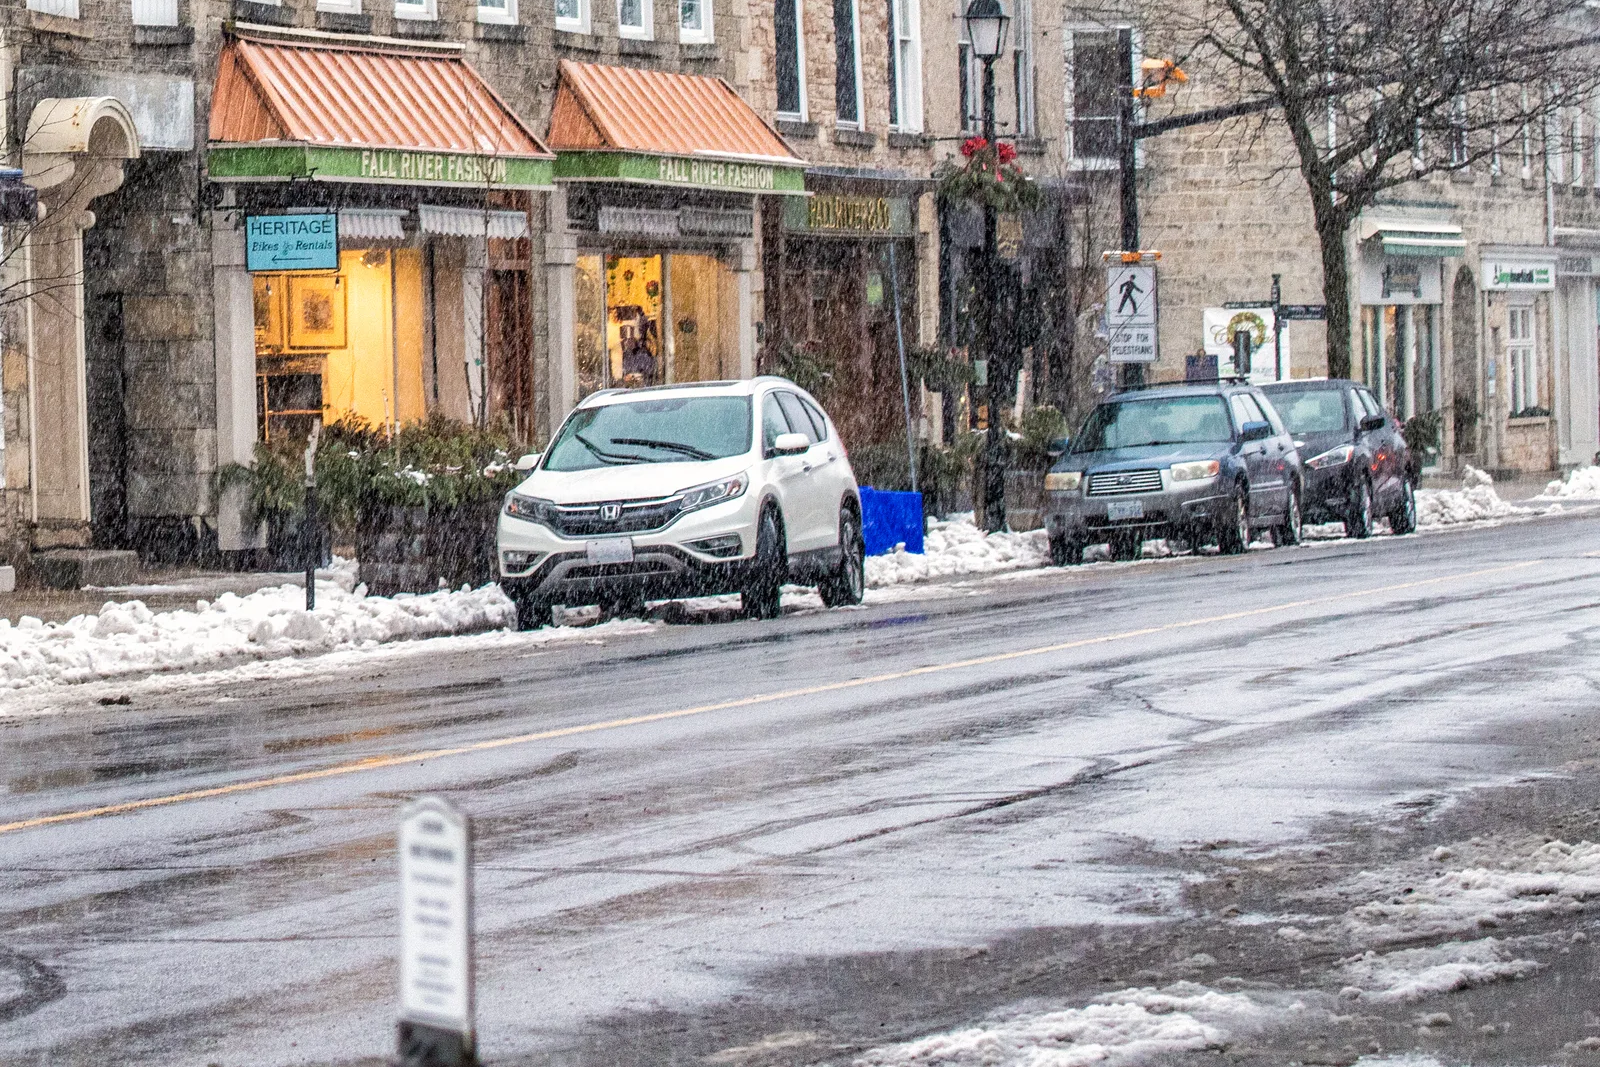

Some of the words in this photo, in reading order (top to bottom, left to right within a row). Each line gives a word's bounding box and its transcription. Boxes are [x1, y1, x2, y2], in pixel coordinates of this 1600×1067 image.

[361, 150, 397, 177] FALL
[401, 152, 444, 180] RIVER
[448, 155, 507, 183] FASHION
[659, 157, 689, 182] FALL
[691, 160, 726, 186] RIVER
[727, 164, 775, 190] FASHION
[251, 219, 332, 236] HERITAGE
[251, 240, 279, 253] Bikes
[295, 239, 333, 252] Rentals
[1136, 332, 1149, 343] FOR
[1111, 344, 1154, 356] PEDESTRIANS
